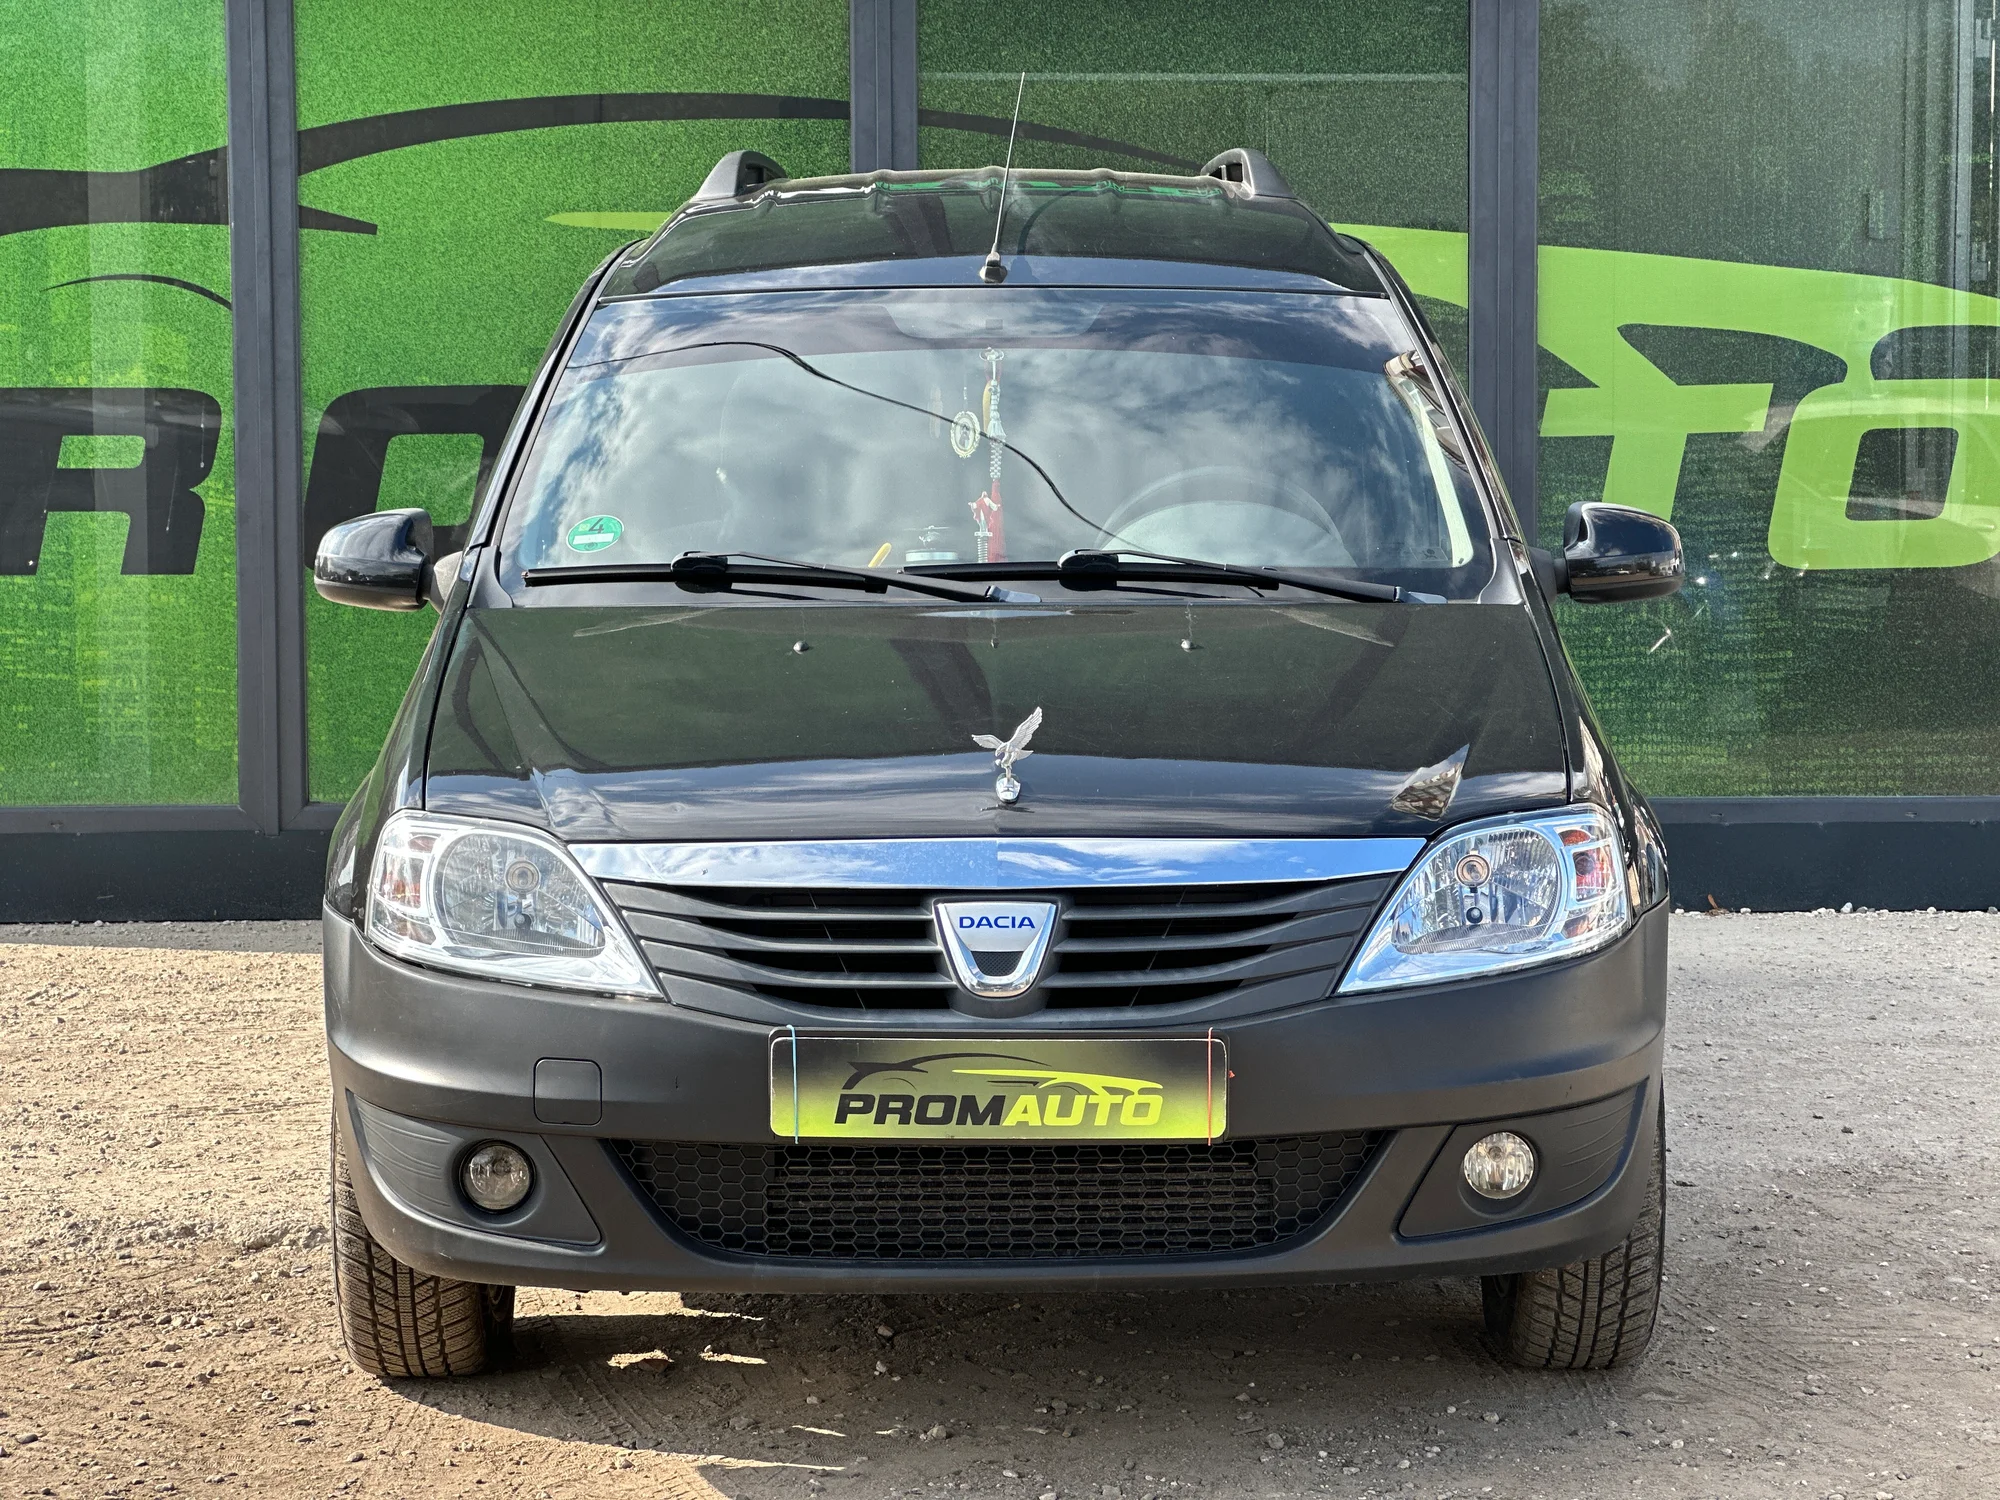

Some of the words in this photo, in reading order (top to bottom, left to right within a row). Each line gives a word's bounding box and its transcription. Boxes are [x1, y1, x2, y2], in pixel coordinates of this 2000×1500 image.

[588, 517, 604, 533] 4
[959, 916, 1035, 929] DACIA
[834, 1094, 1163, 1126] PROMAUTO
